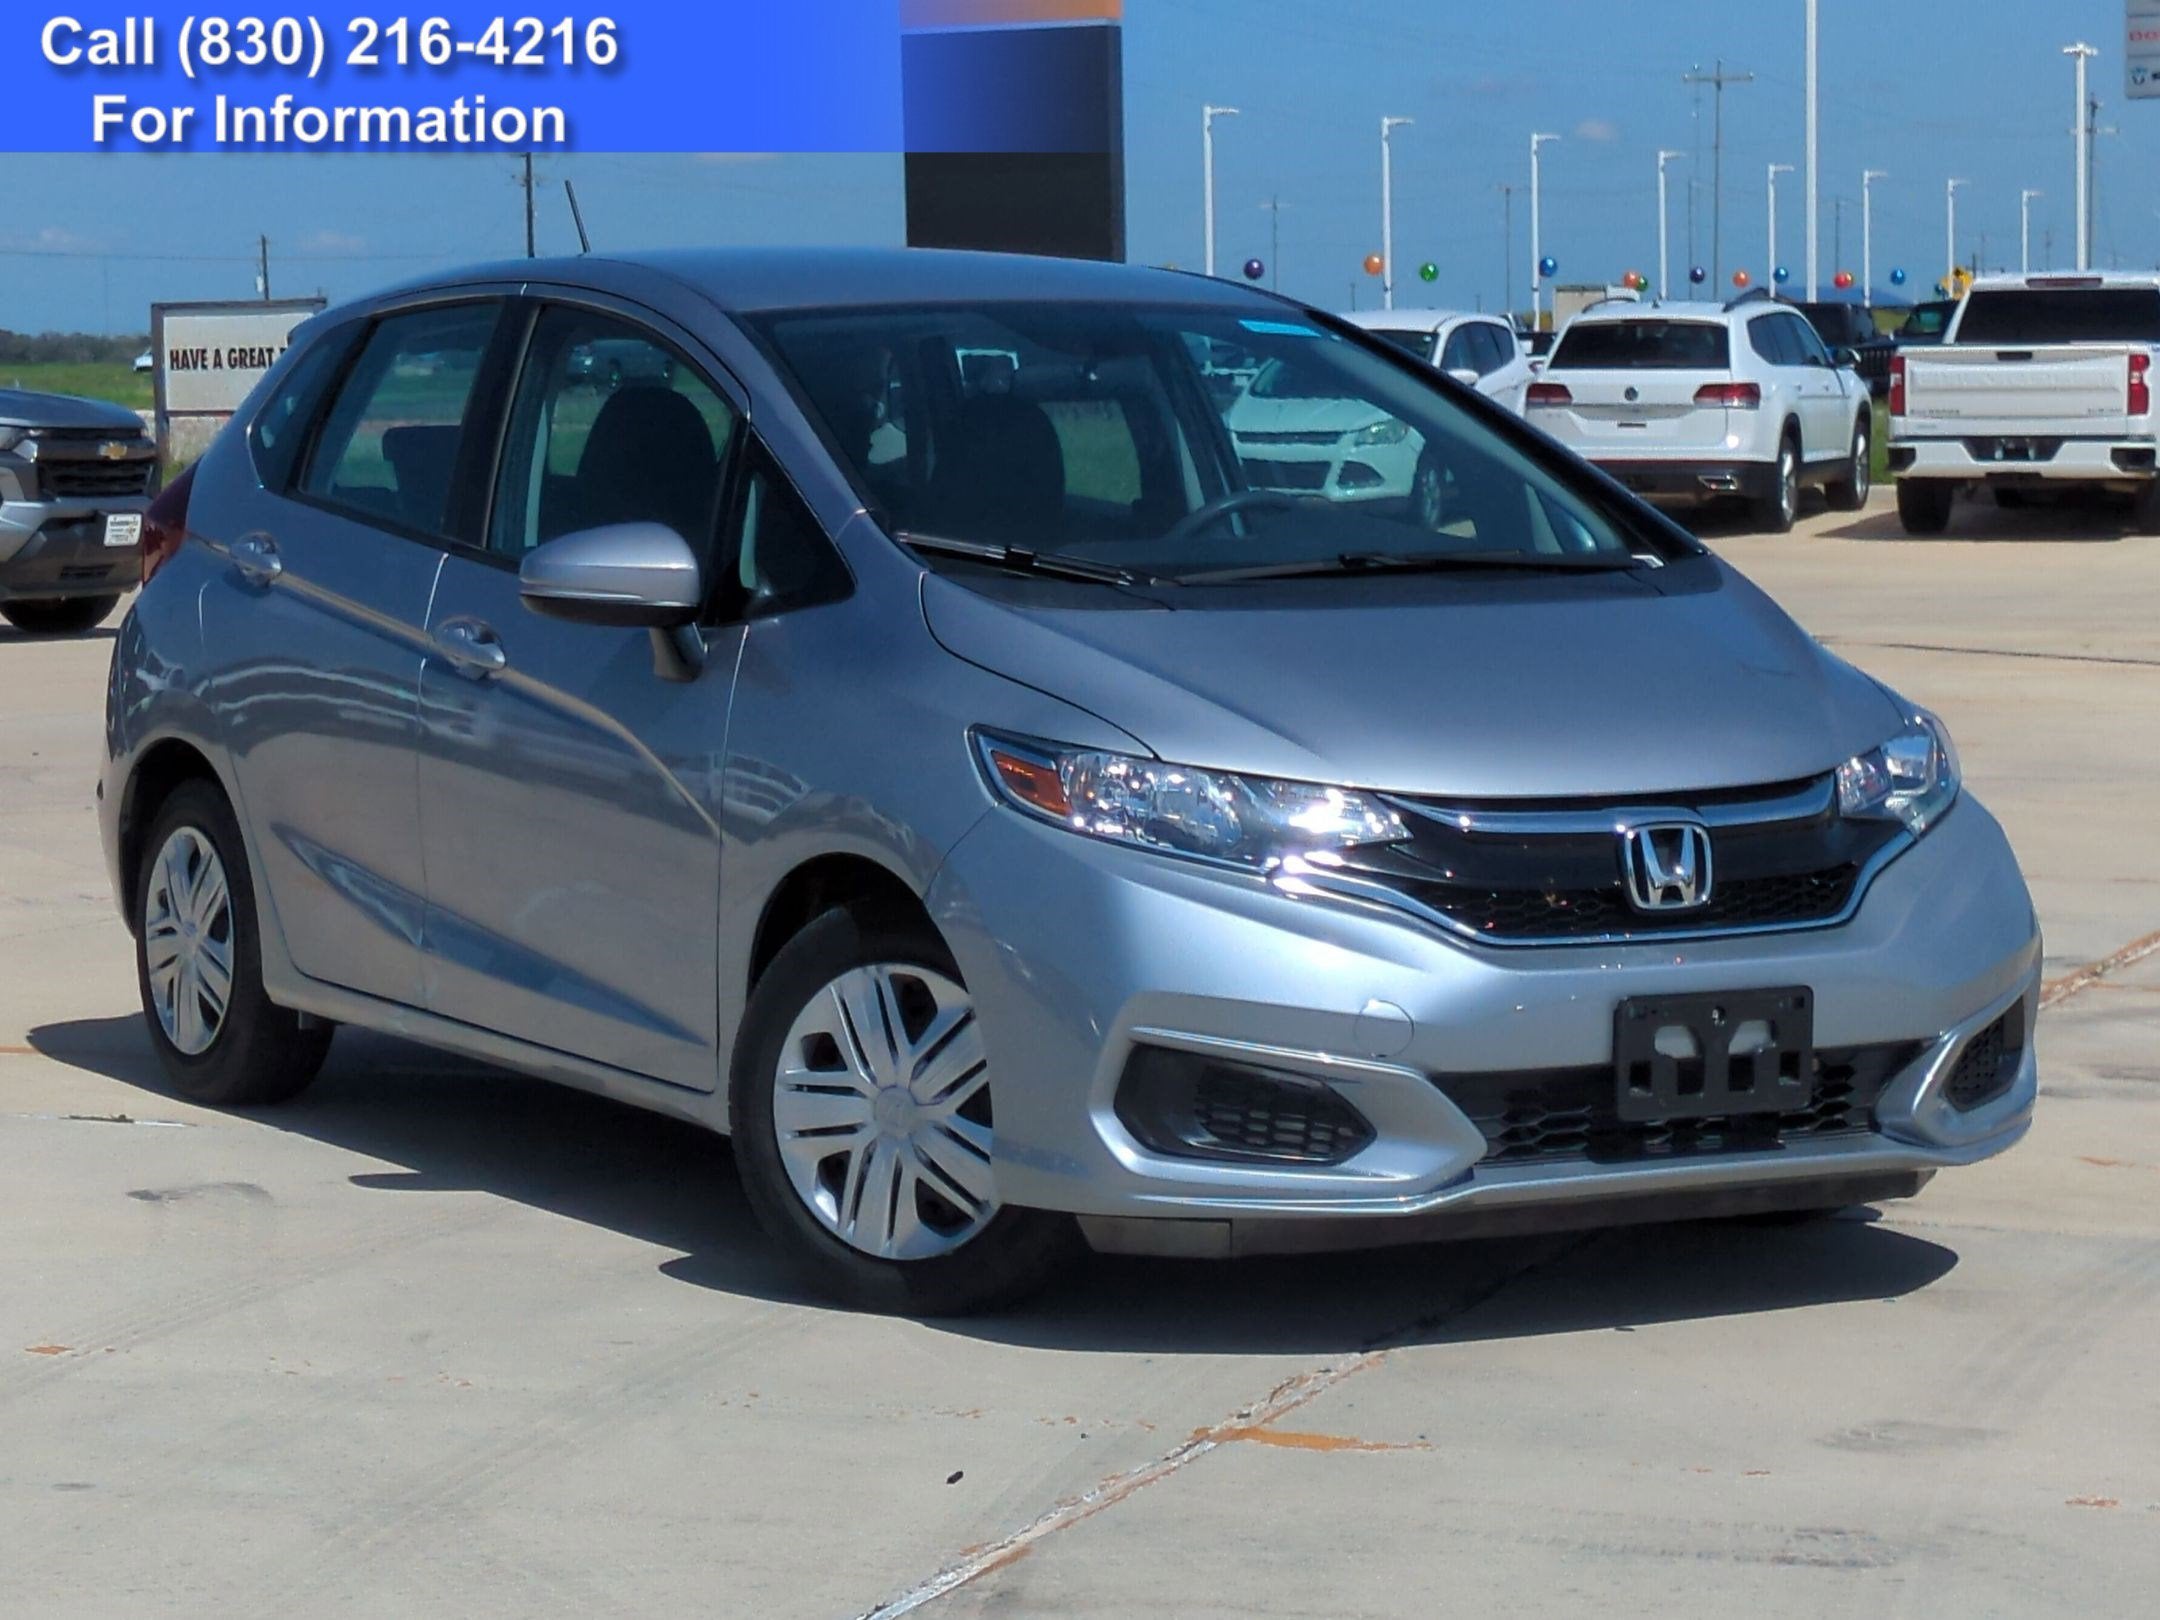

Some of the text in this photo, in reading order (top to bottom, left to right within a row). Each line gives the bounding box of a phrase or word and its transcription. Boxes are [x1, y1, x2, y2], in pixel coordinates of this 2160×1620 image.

[169, 347, 275, 370] HAVE A GREAT
